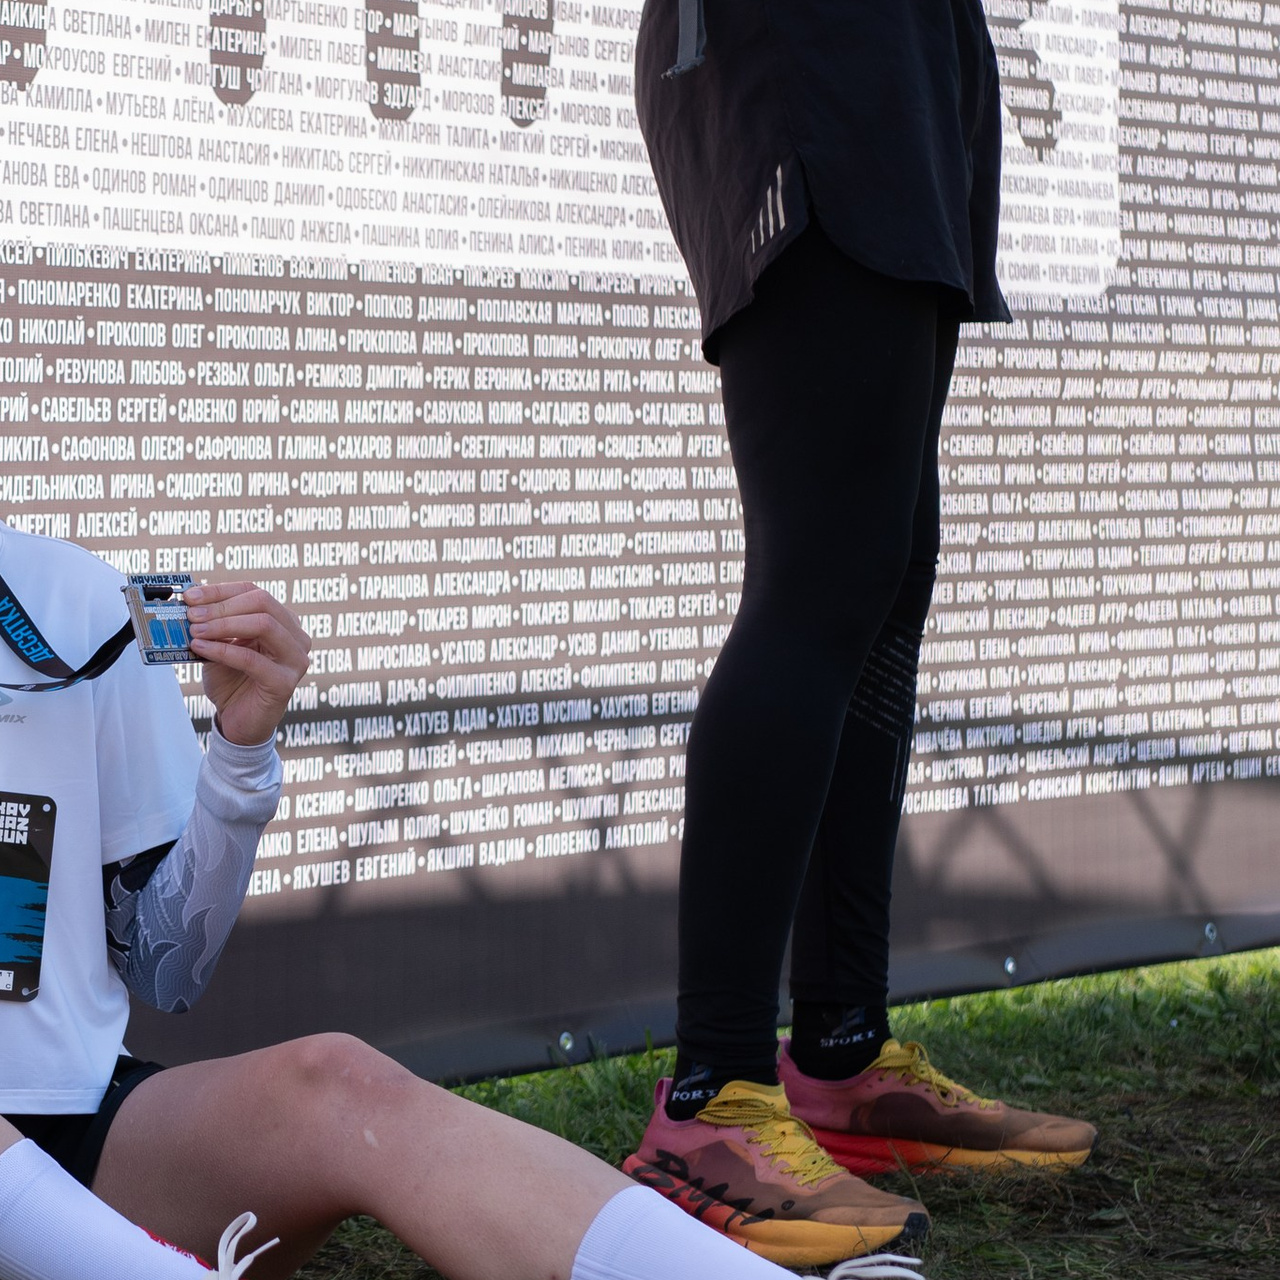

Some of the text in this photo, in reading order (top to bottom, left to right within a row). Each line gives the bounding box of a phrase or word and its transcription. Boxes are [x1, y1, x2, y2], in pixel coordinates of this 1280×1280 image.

[9, 120, 270, 165] НЕЧАЕВА ЕЛЕНА НЕШТОВА АНАСТАСИЯ
[54, 165, 79, 190] ЕВА
[93, 167, 146, 194] ОДИНОВ
[152, 172, 196, 198] РОМАН
[477, 298, 604, 326] ПОПЛАВСКАЯ МАРИНА
[305, 362, 532, 391] РЕМИЗОВ ДМИТРИЙ РЕРИХ ВЕРОНИКА
[285, 698, 591, 748] ХАСАНОВА ДИАНА ХАТУЕВ АДАМ ХАТУЕВ МУСЛИМ
[535, 818, 669, 859] ЯЛОВЕНКО АНАТОЛИЙ
[672, 1089, 718, 1101] PORT
